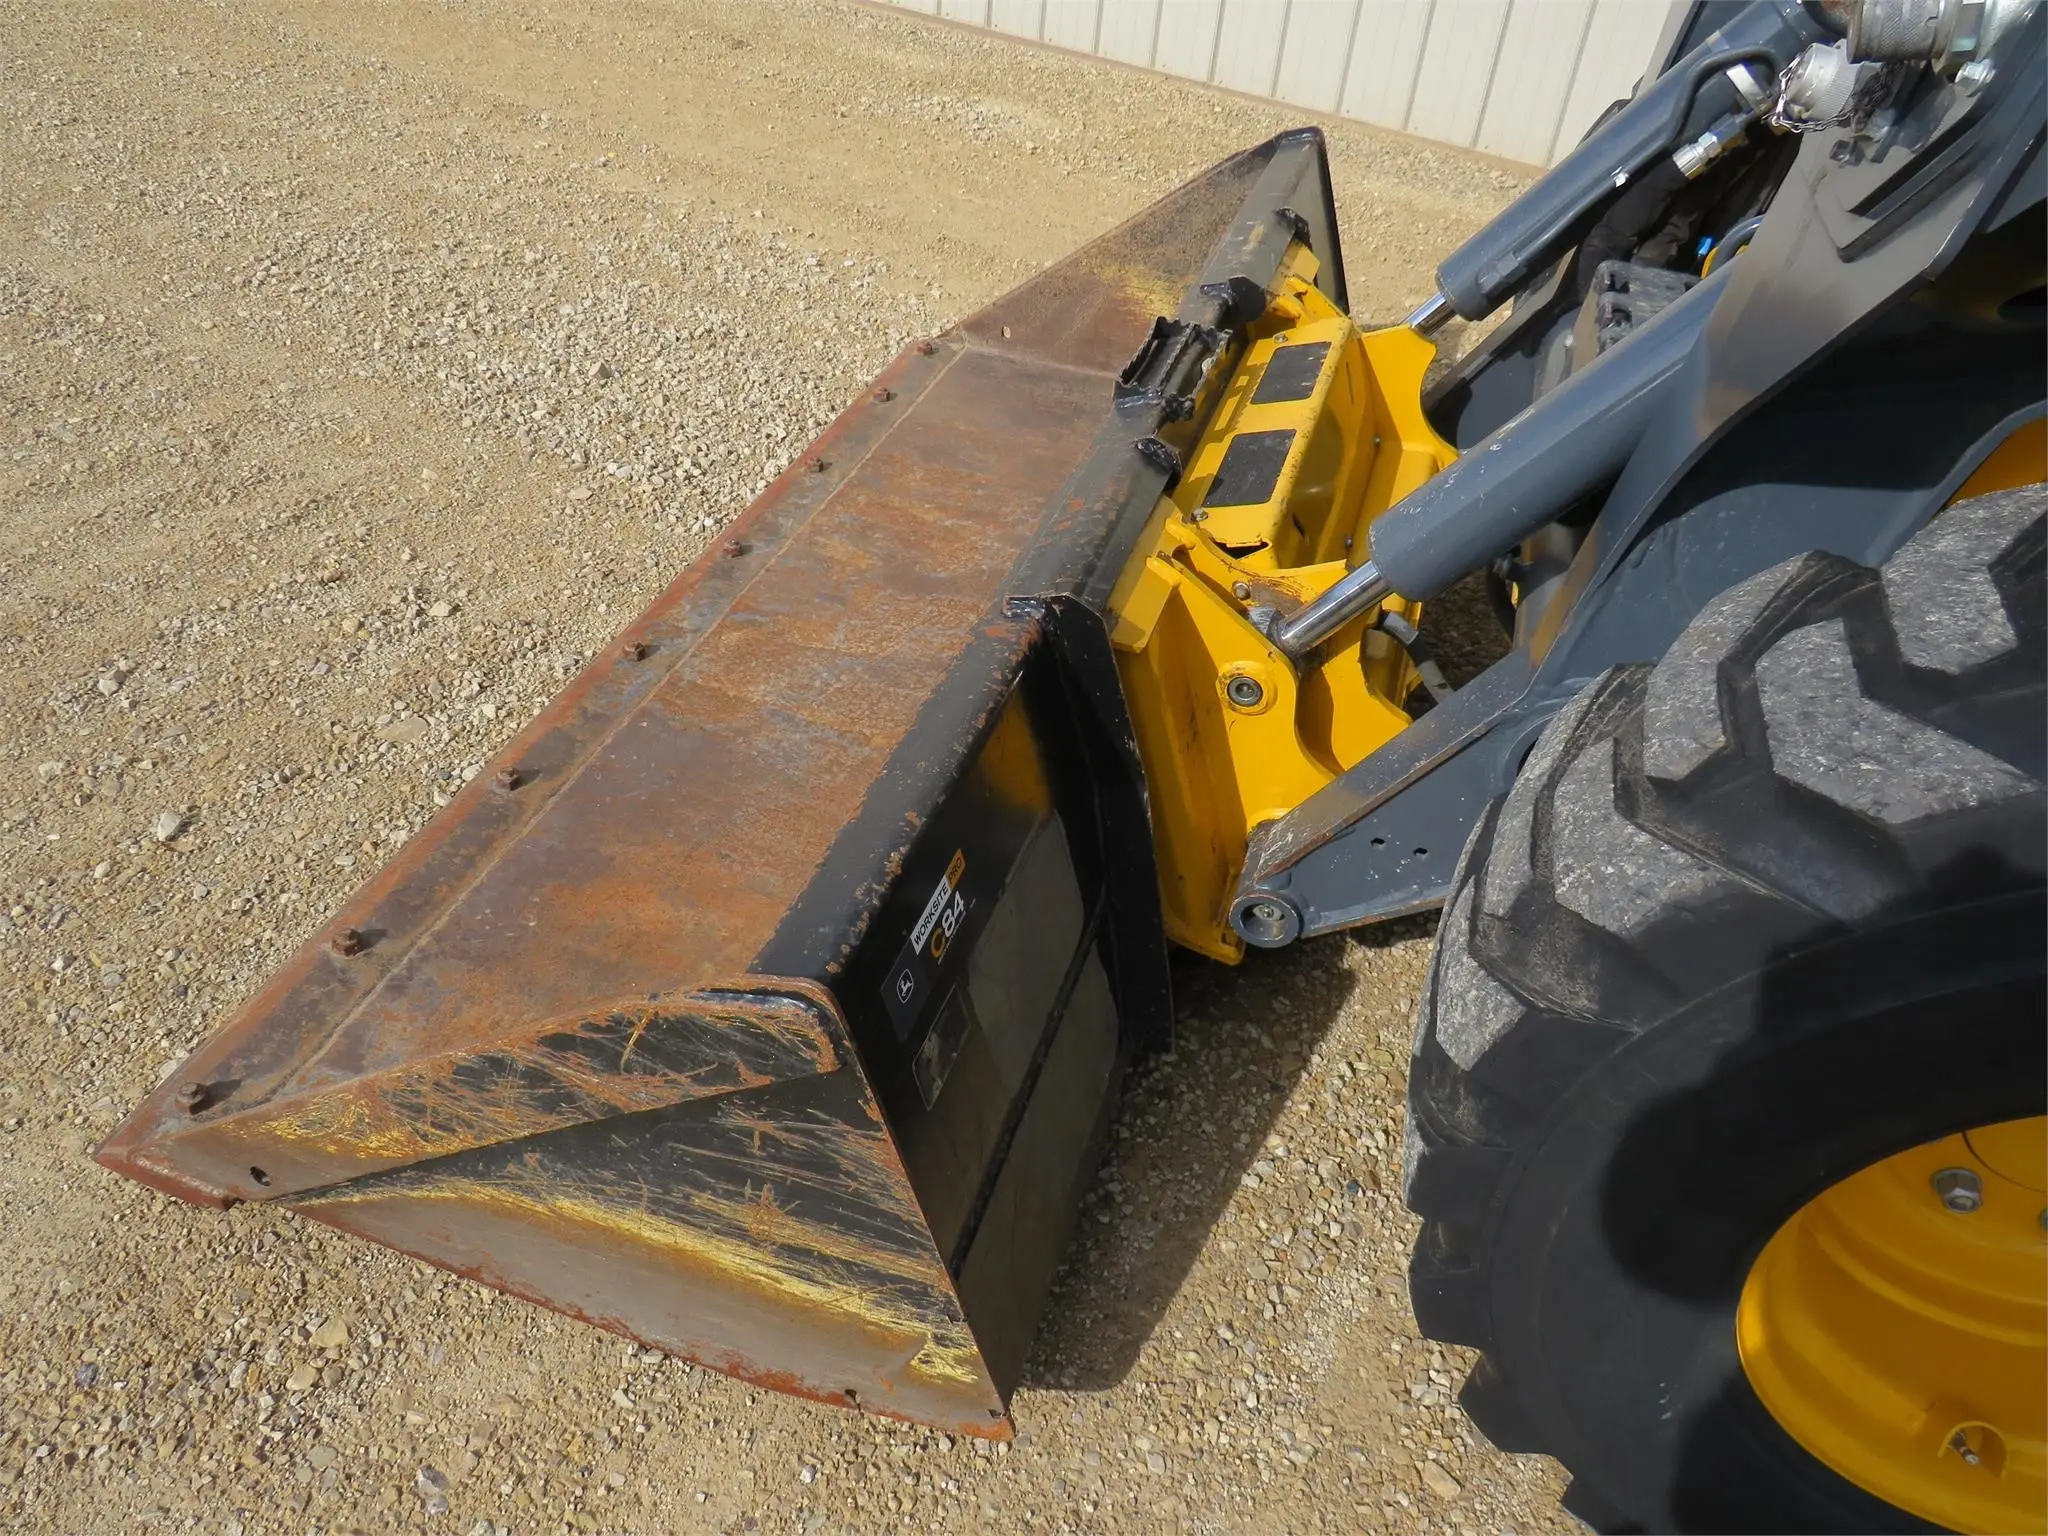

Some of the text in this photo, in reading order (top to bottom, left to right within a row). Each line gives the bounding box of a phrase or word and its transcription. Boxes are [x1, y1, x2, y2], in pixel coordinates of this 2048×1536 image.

[913, 882, 950, 946] WORKSITE
[947, 856, 962, 885] PRO
[930, 890, 965, 958] C84
